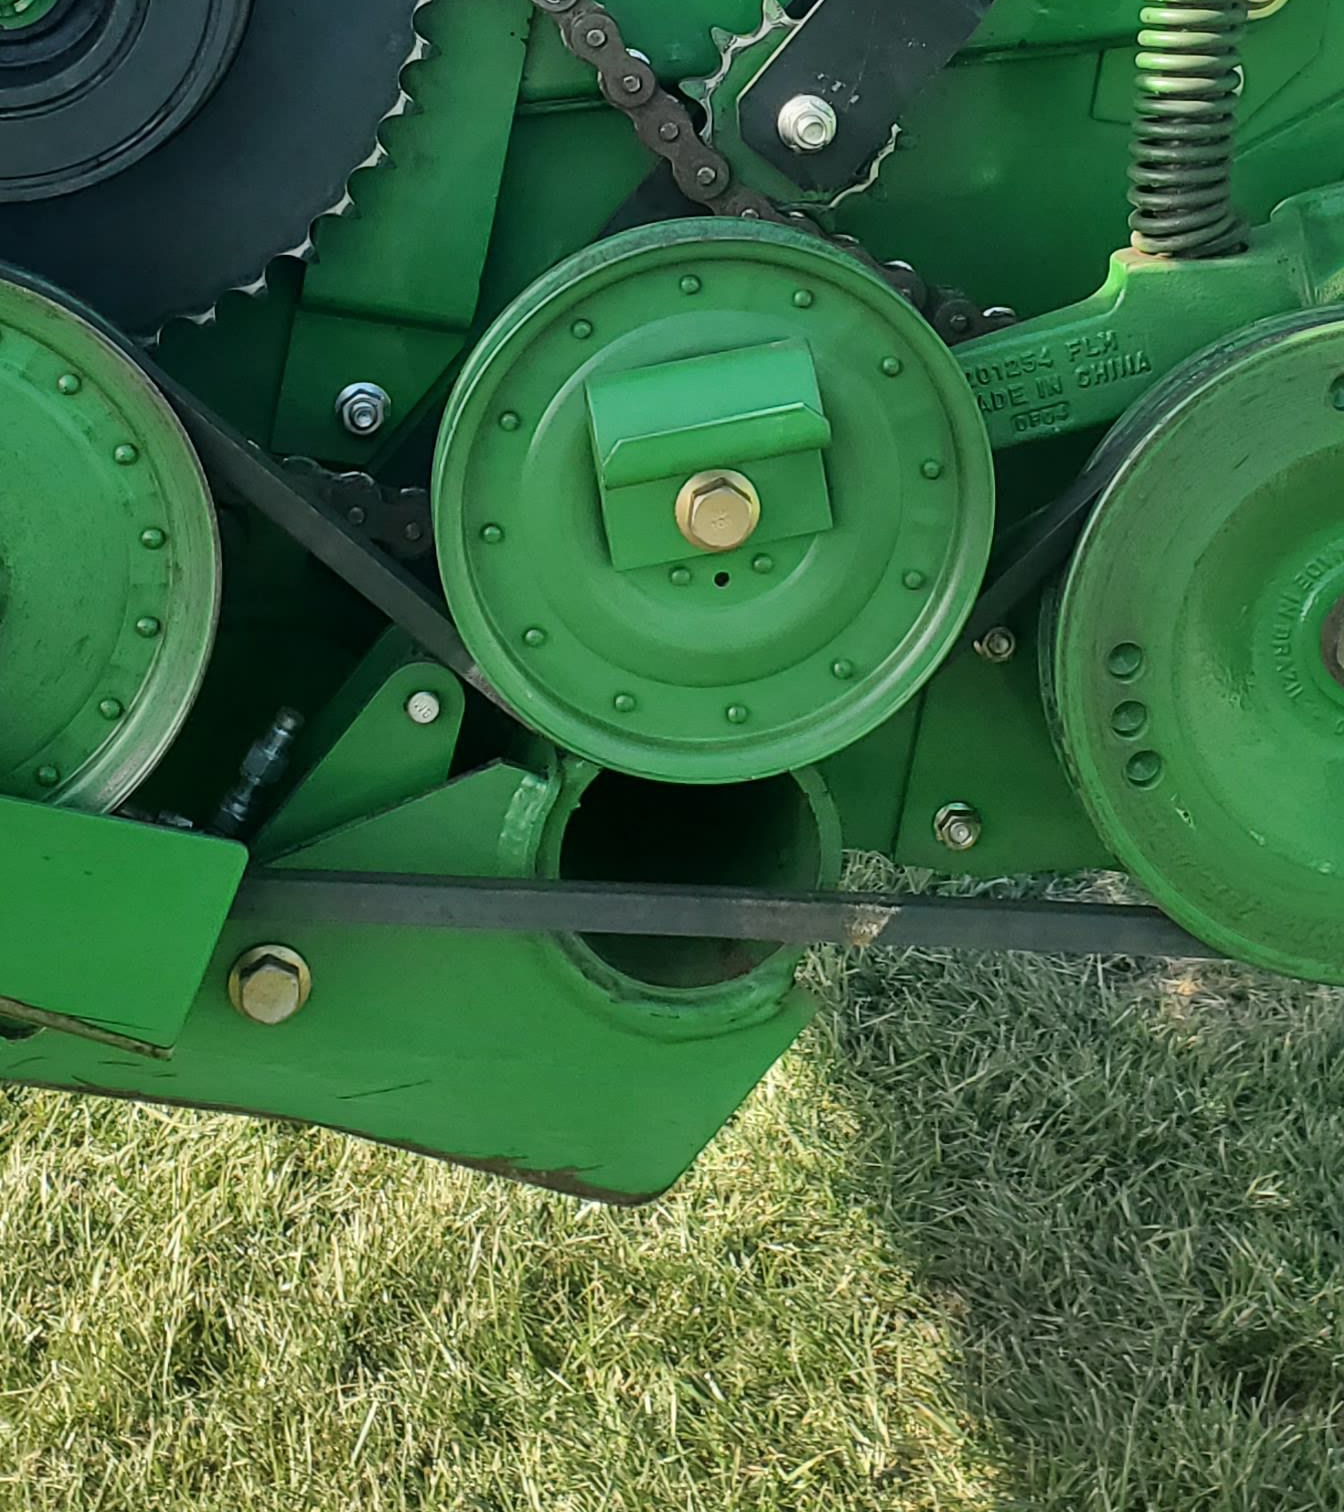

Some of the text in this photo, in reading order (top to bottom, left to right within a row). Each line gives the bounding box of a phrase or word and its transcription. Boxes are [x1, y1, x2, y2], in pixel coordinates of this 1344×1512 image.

[977, 350, 1153, 414] ADE IN CHINA
